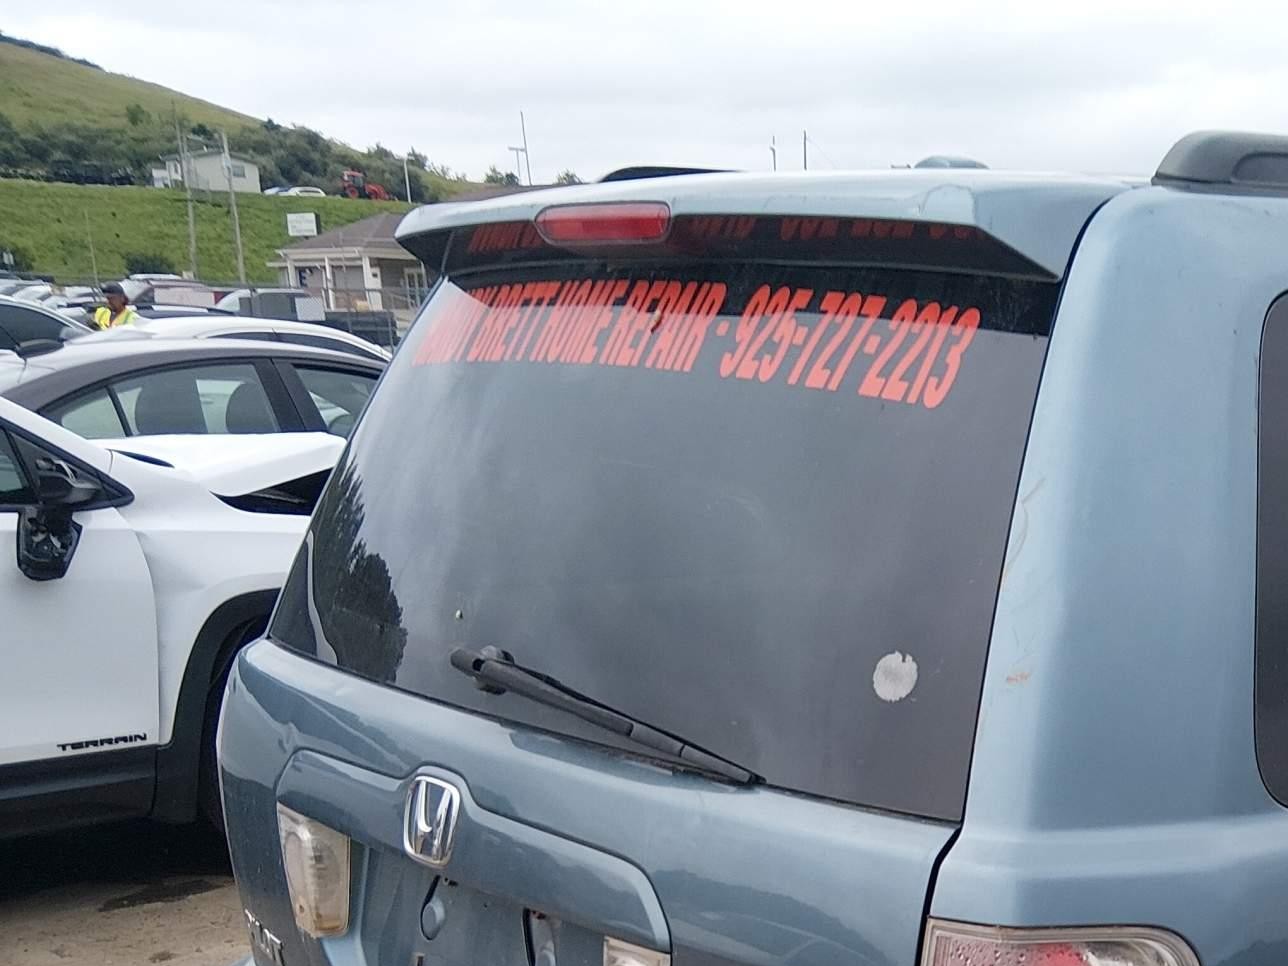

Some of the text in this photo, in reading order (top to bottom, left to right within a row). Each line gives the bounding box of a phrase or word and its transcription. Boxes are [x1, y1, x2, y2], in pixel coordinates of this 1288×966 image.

[467, 281, 561, 362] BRETT
[529, 279, 629, 364] HOME
[599, 280, 727, 373] REPAIR
[719, 284, 980, 409] 925-727-2213
[57, 732, 148, 751] TERRAIN
